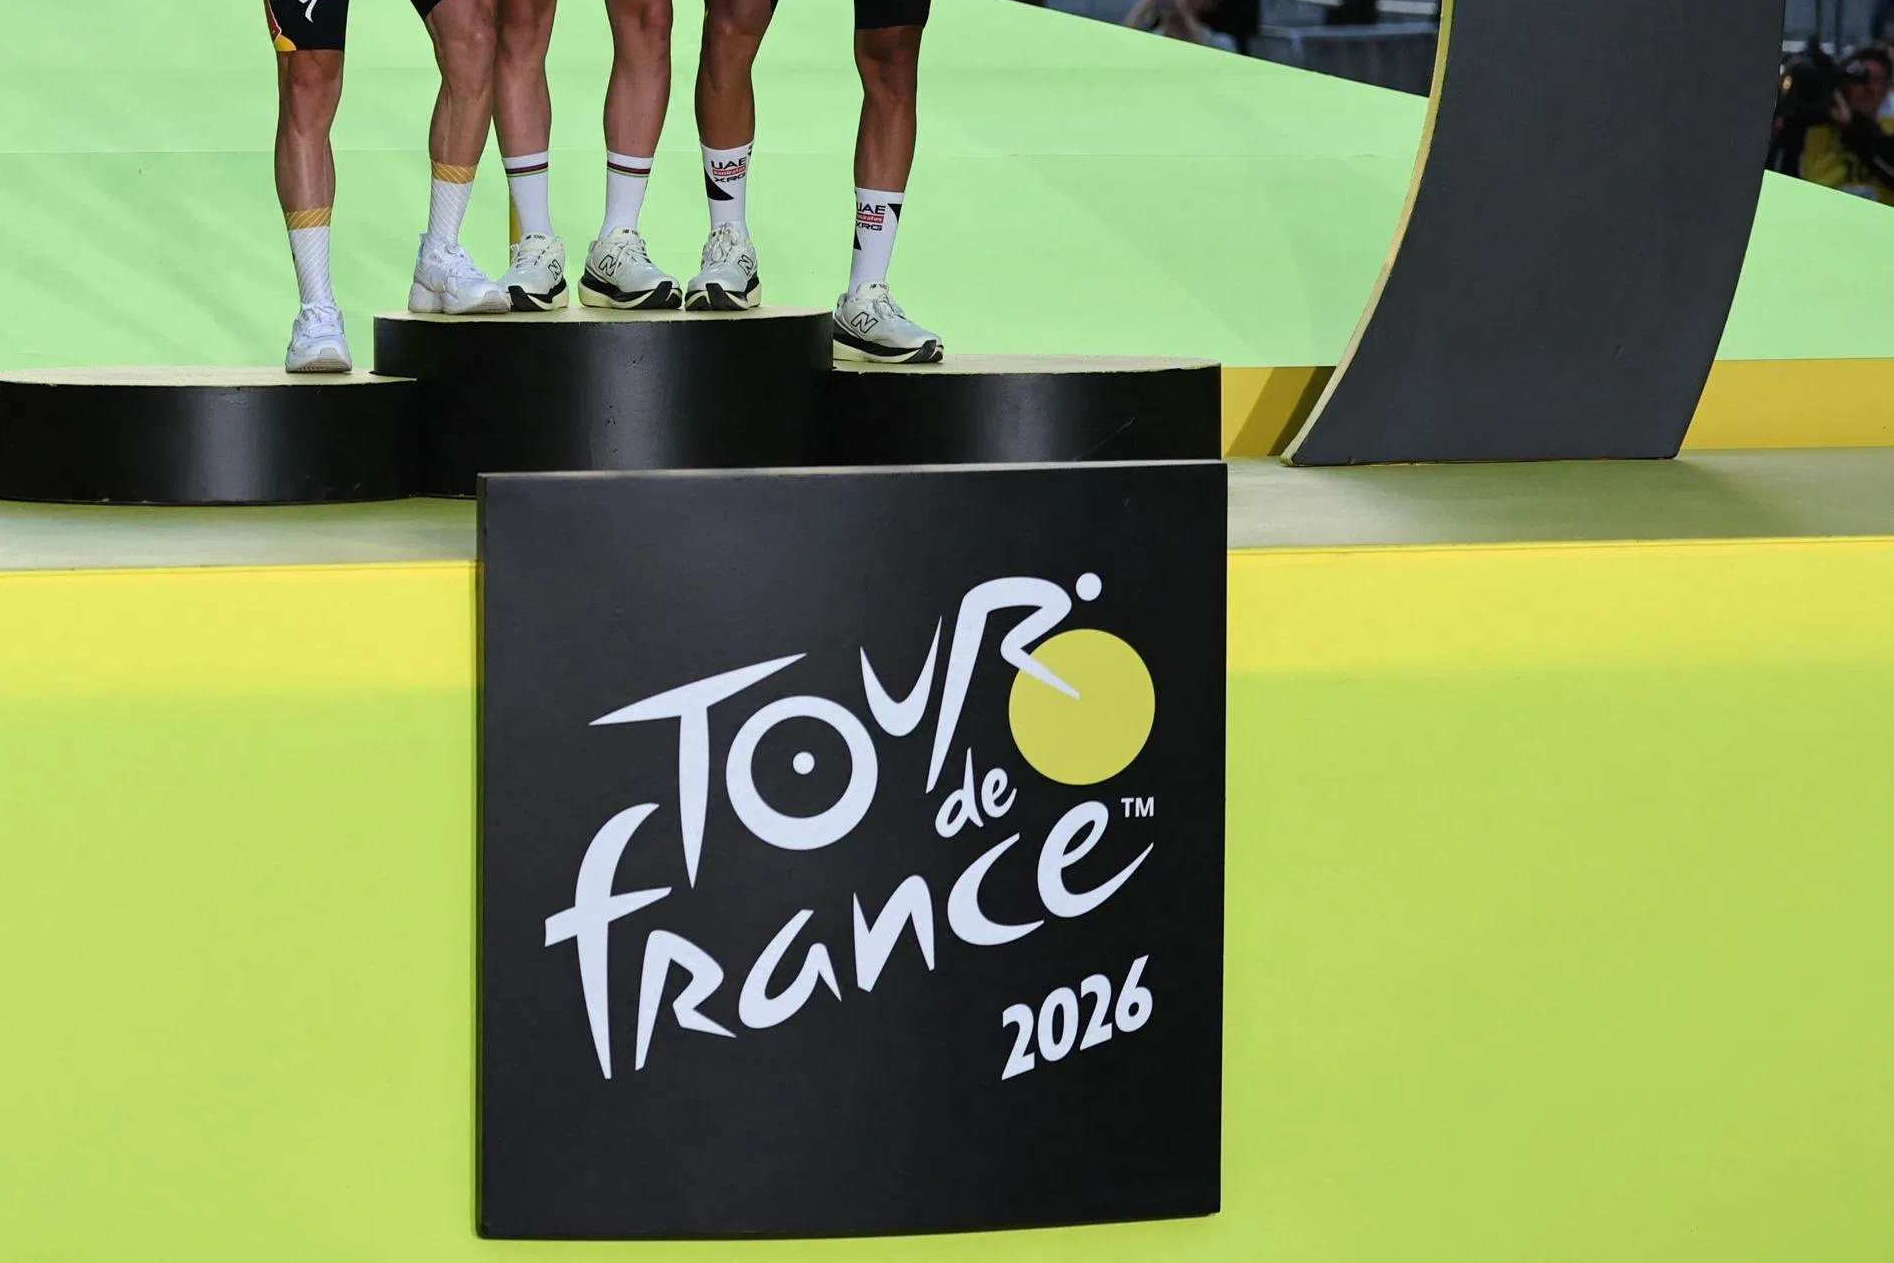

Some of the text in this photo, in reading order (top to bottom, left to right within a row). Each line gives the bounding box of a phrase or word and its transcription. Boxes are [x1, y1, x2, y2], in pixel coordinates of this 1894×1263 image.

[710, 156, 747, 170] UAE
[588, 572, 1102, 888] TOUR
[934, 747, 1018, 838] de
[1001, 955, 1154, 1080] 2026
